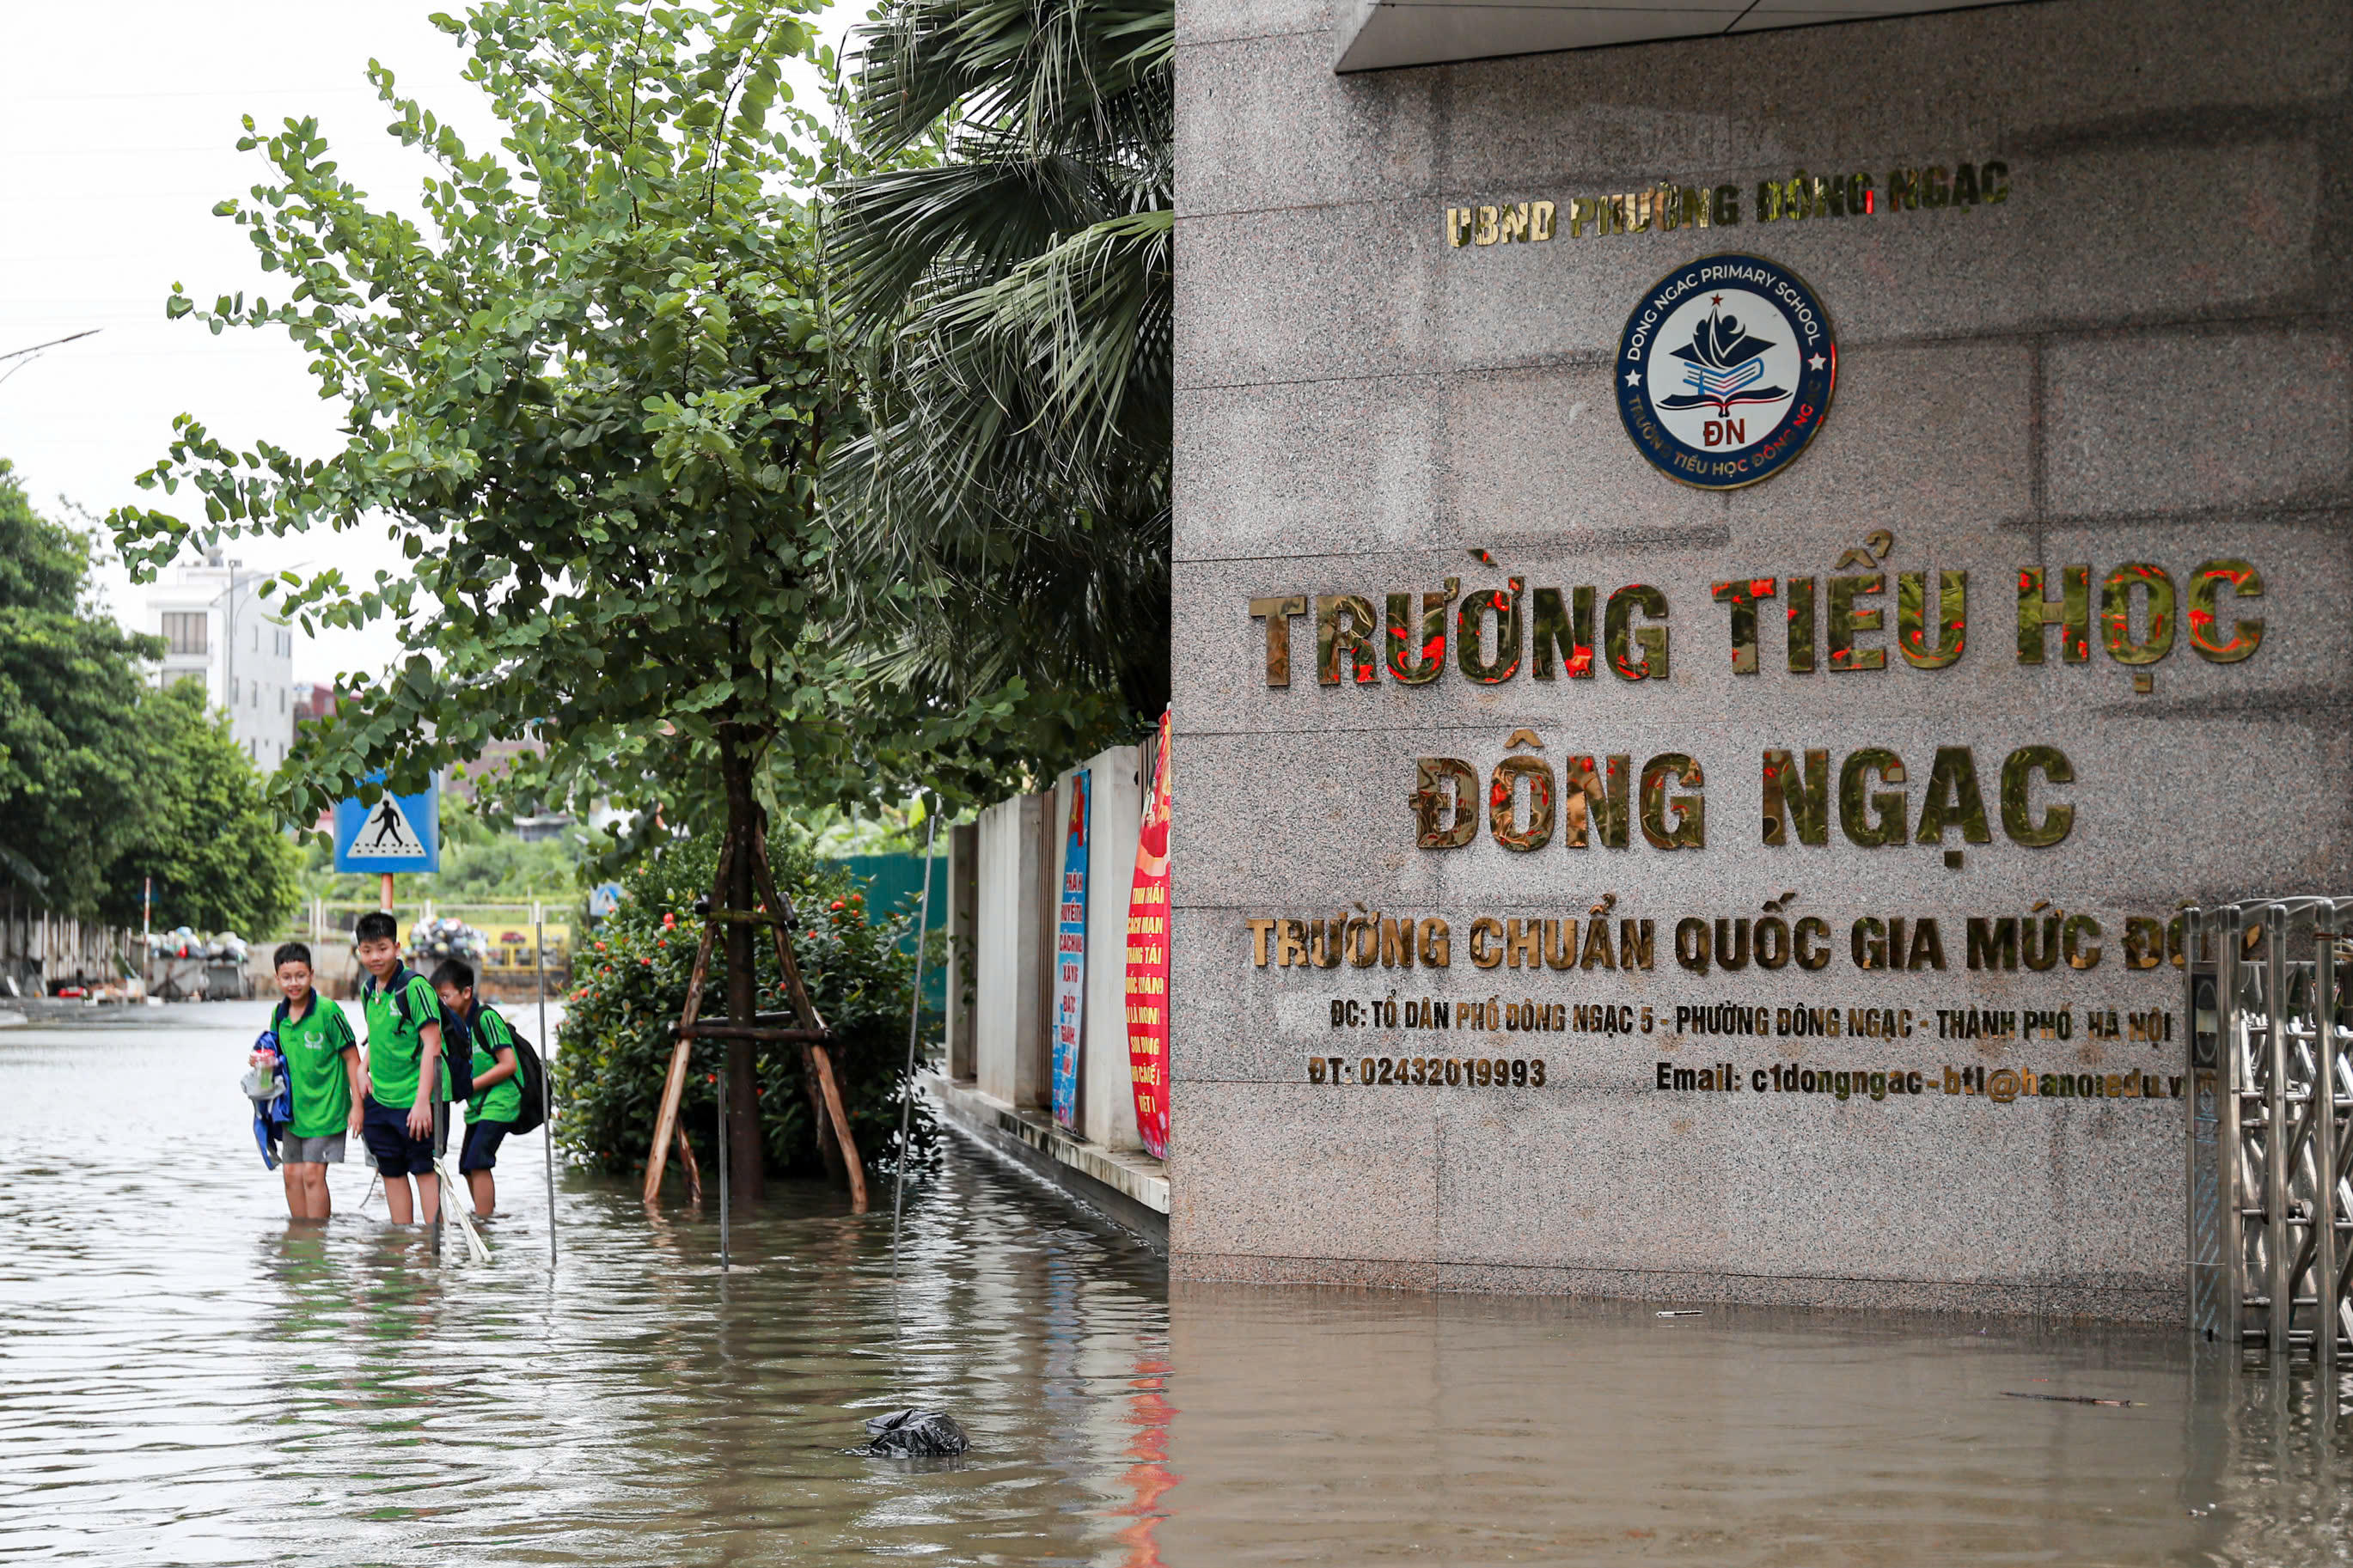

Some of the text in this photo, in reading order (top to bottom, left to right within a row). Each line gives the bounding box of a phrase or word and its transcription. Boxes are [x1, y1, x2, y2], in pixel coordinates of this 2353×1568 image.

[1446, 200, 1556, 247] UBND
[1570, 179, 1739, 237] PHƯỜNG
[1627, 265, 1821, 361] DONG NGAC PRIMARY SCHOOL
[1674, 452, 1708, 474] TIỂU
[1712, 459, 1749, 478] HỌC
[1703, 418, 1745, 447] ĐN
[1249, 528, 2263, 694] TRƯỜNG TIỂU HỌC
[1409, 729, 2075, 868] ĐÔNG NGẠC
[1245, 901, 1450, 968] TRƯỜNG
[1470, 894, 1655, 970] CHUẨN
[1675, 892, 1831, 976] QUỐC
[1851, 917, 1947, 970] GIA
[1966, 900, 2102, 971] MỨC
[1331, 1000, 1366, 1028] ĐC:
[1372, 989, 1397, 1029] TỔ
[1405, 997, 1450, 1030] DÂN
[1456, 995, 1500, 1031] PHỐ
[1505, 998, 1565, 1032] ĐÔNG
[1573, 1004, 1634, 1038] NGẠC
[1641, 1006, 1653, 1033] 5
[1677, 1000, 1769, 1036] PHƯỜNG
[1776, 1003, 1841, 1037] ĐÔNG
[1848, 1008, 1913, 1042] NGẠC
[1936, 1004, 2015, 1040] THÀNH
[2023, 1002, 2072, 1040] PHỐ
[2087, 1004, 2120, 1040] HÀ
[2129, 1006, 2172, 1048] NỘI
[1308, 1058, 2186, 1102] ĐT: 02432019993 Email: c1dongngac-btl@hanoiedu.v
